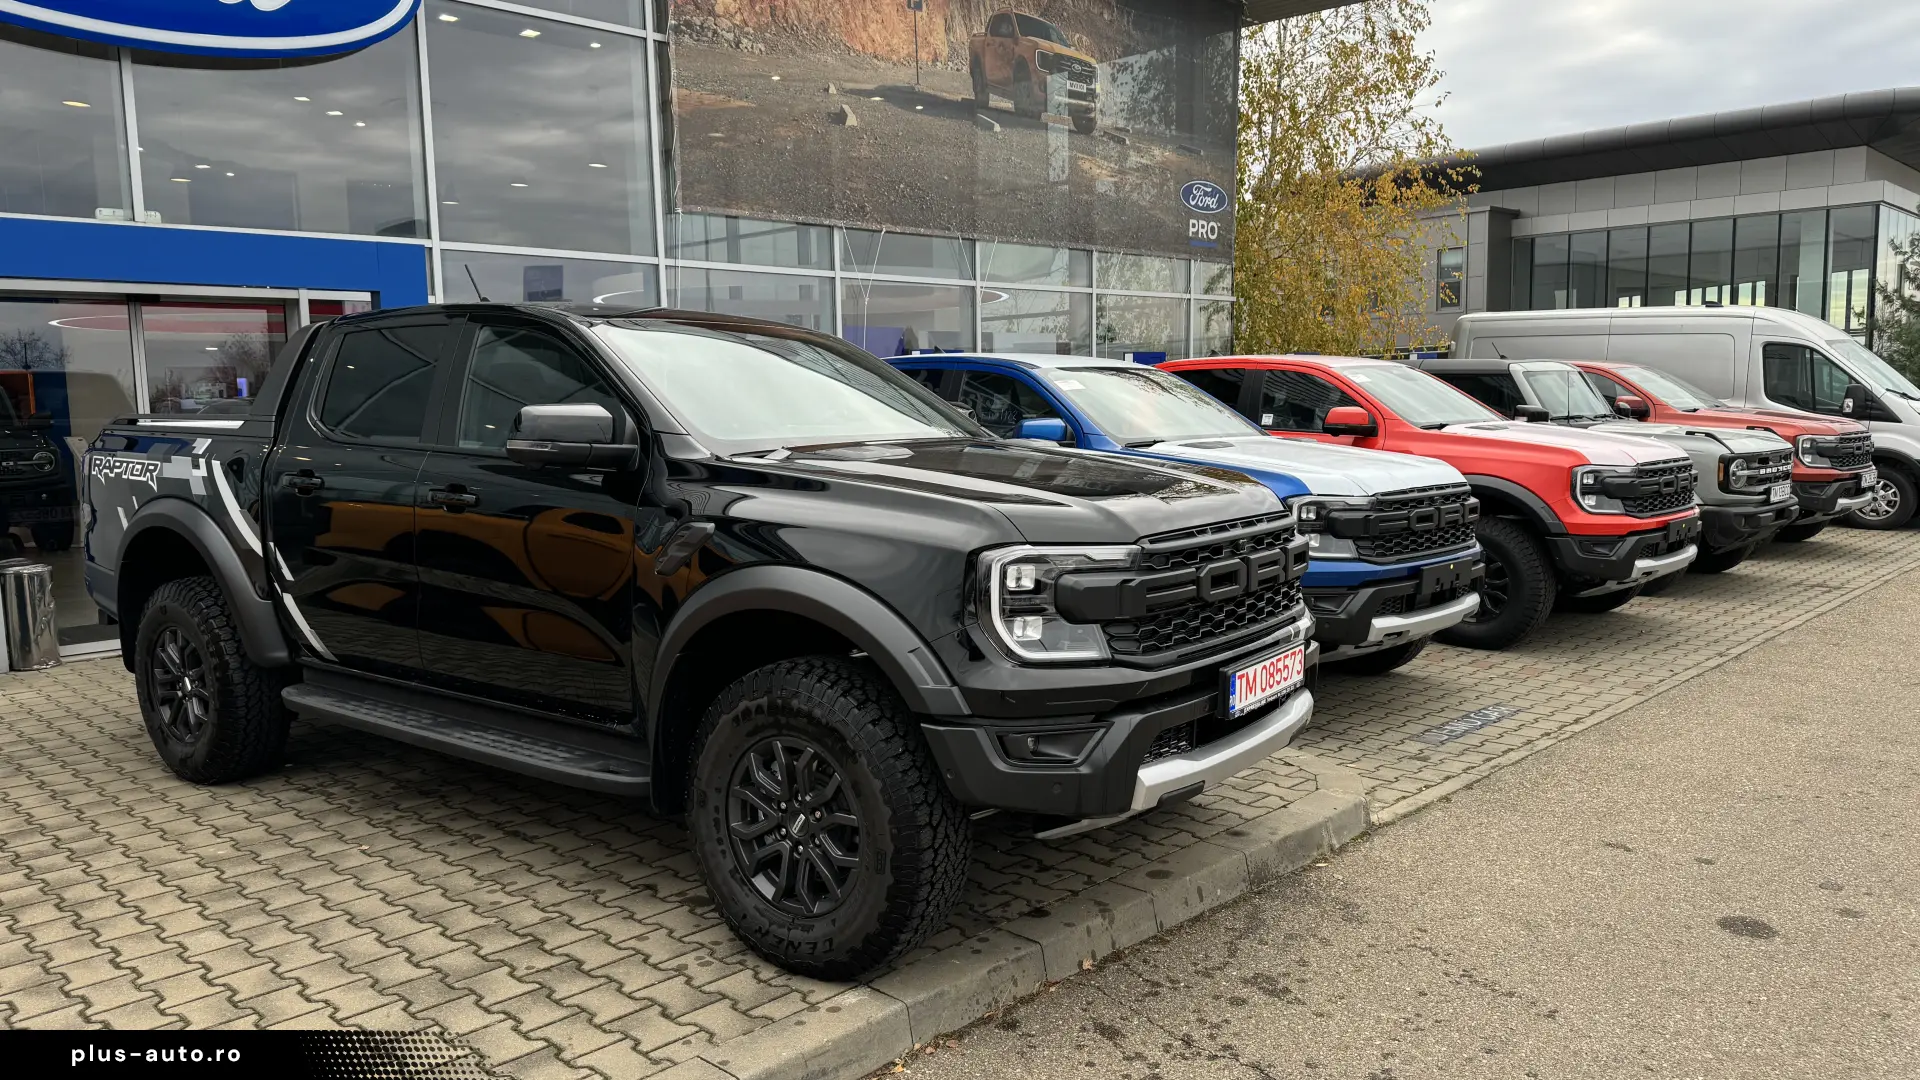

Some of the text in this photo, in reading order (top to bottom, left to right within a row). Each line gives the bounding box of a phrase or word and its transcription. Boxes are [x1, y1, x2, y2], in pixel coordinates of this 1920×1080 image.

[1189, 184, 1220, 209] Ford
[1189, 219, 1218, 239] PRO
[91, 456, 160, 492] RAPTOR
[1760, 465, 1792, 475] BRONCO
[1367, 497, 1480, 535] FORD
[1120, 536, 1310, 618] FORD
[1237, 667, 1258, 704] TM
[1260, 648, 1304, 693] 085573
